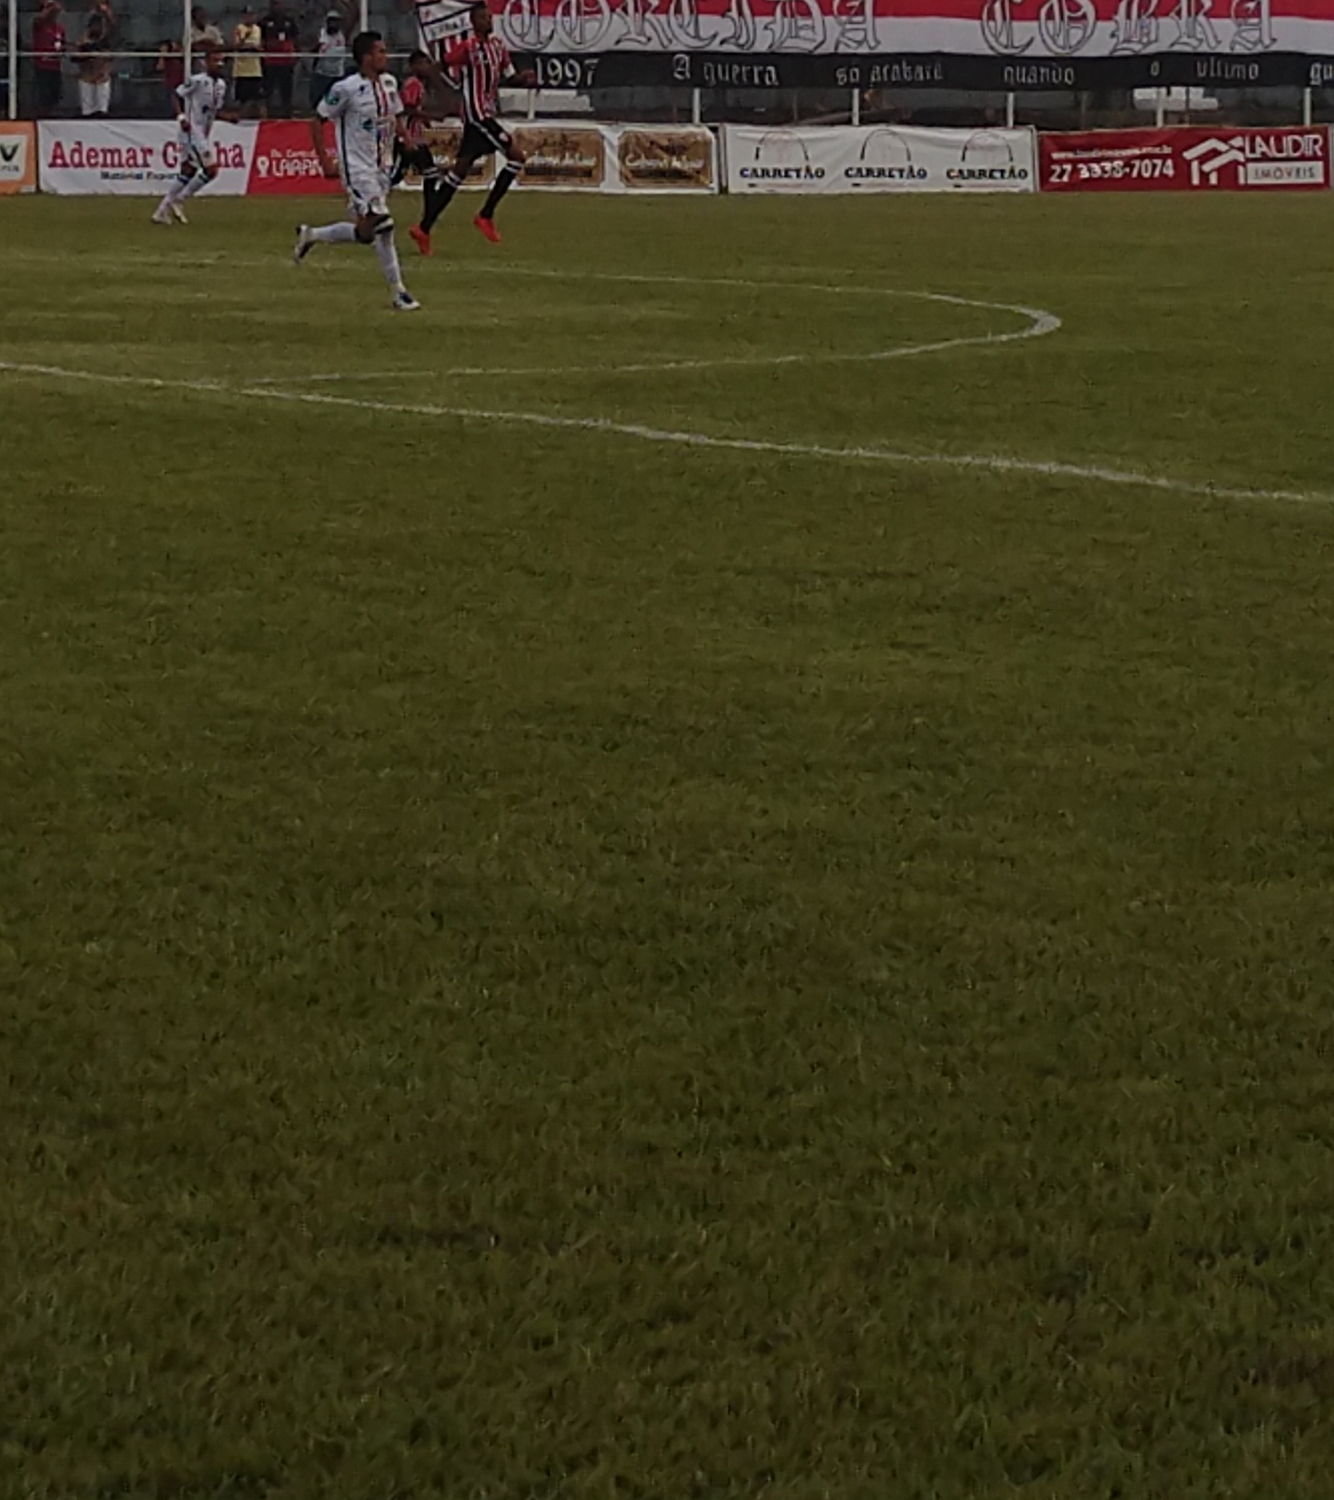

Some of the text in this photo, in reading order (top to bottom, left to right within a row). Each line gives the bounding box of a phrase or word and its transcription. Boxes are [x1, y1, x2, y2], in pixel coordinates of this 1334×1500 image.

[535, 57, 600, 86] 1997
[48, 140, 246, 168] Ademar Cha
[1244, 134, 1323, 158] LAUDIR
